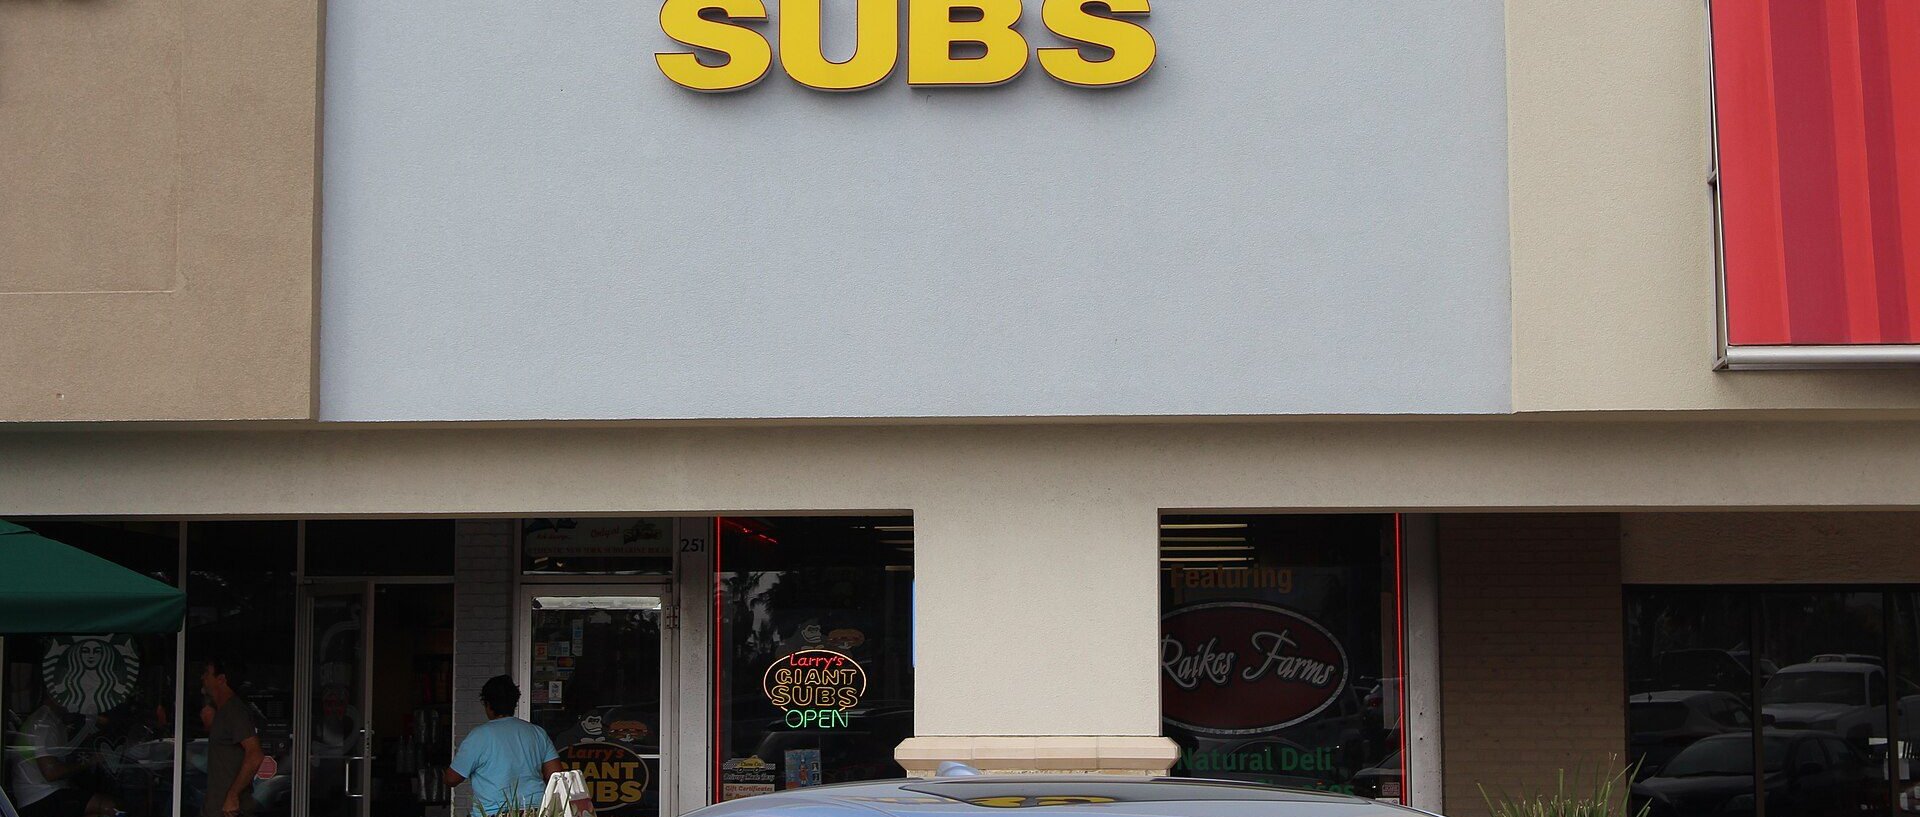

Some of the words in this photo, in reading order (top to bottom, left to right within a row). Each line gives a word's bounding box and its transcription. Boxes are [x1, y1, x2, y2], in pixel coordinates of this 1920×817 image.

[655, 0, 1157, 91] SUBS
[681, 539, 704, 553] 251
[1170, 564, 1293, 594] Featuring
[790, 653, 845, 670] Larry's
[1161, 634, 1234, 688] Raikes
[1242, 629, 1335, 685] Farms
[775, 668, 857, 686] GIANT
[771, 685, 858, 708] SUBS
[785, 709, 849, 728] OPEN
[567, 745, 625, 760] Larry's
[1177, 745, 1273, 771] Natural
[1281, 745, 1332, 771] Deli
